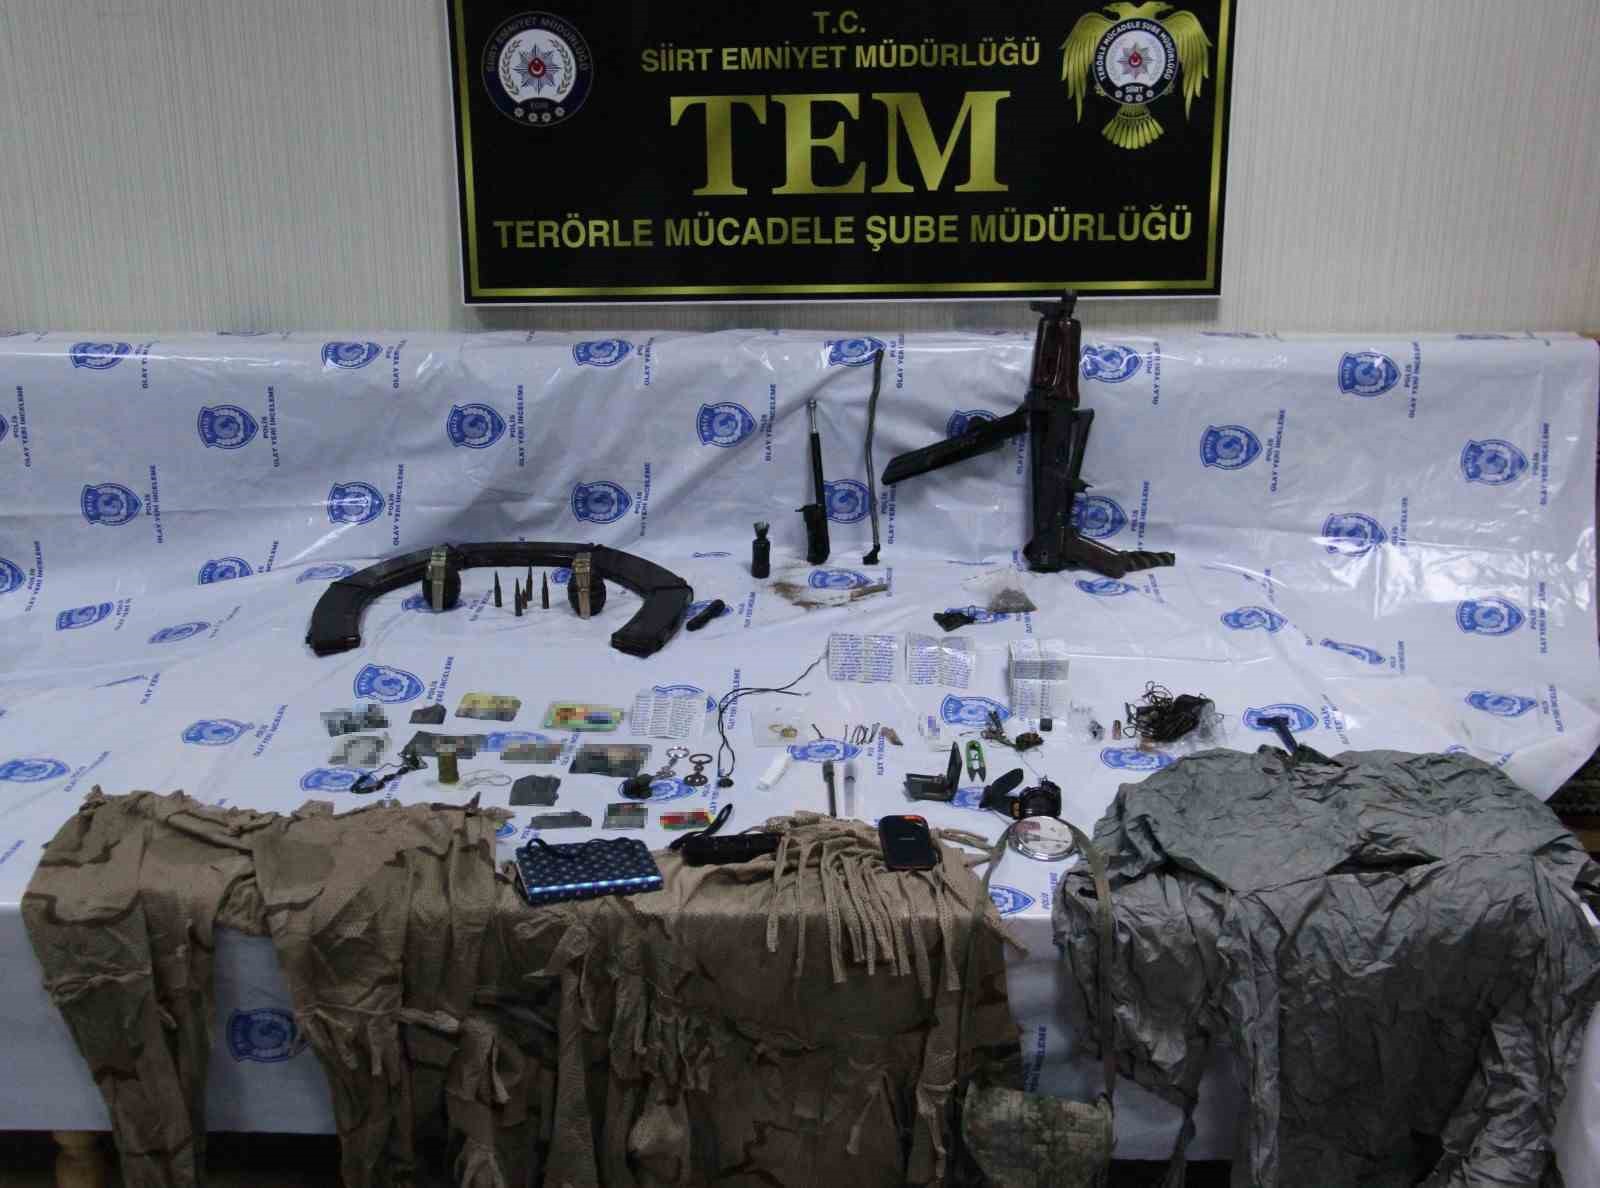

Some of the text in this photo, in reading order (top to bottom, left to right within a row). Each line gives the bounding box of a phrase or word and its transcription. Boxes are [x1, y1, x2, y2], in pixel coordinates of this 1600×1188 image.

[813, 11, 866, 34] T.C.
[641, 36, 1041, 72] SİİRT EMNİYET MÜDÜRLÜĞÜ
[670, 90, 1011, 196] TEM
[493, 203, 1193, 252] TERÖRLE MÜCADELE ŞUBE MÜDÜRLÜĞÜ
